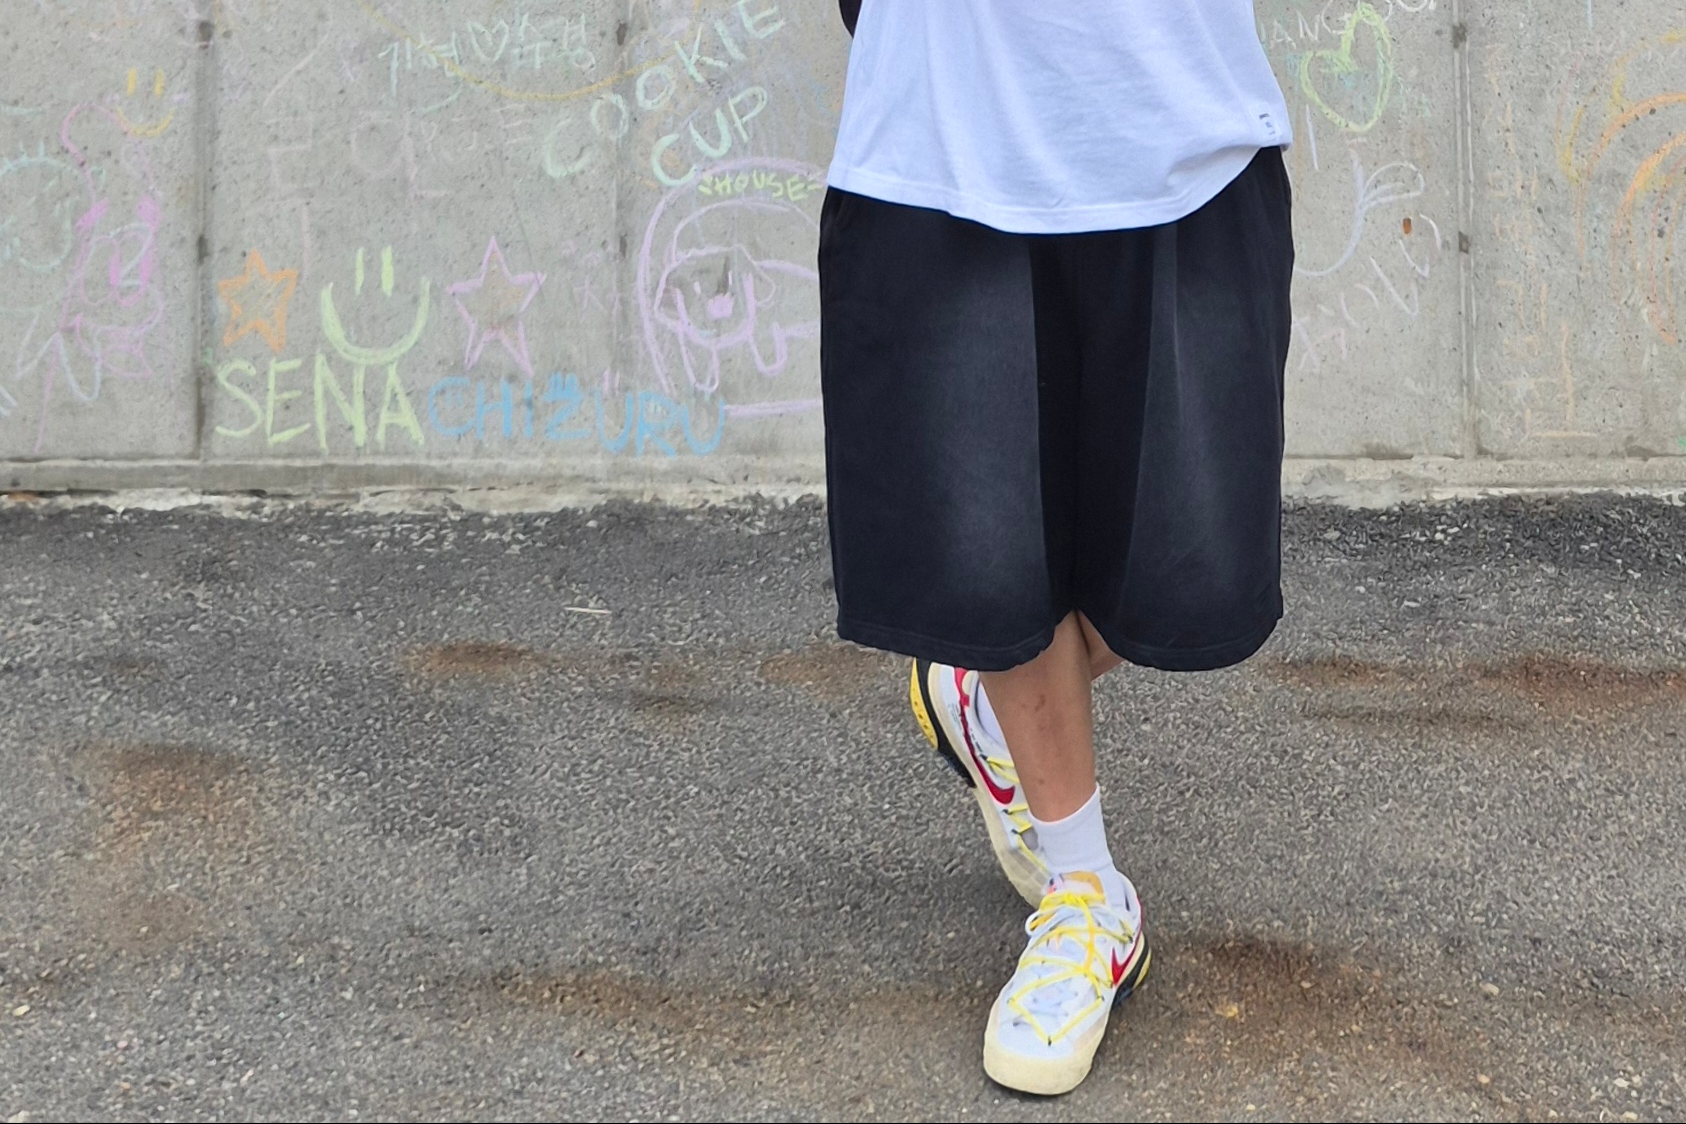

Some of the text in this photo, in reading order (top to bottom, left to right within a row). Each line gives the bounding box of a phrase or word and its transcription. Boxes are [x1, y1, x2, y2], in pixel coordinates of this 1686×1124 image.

[650, 86, 769, 188] CUP
[714, 169, 806, 202] HOUSE
[215, 351, 425, 456] SENA
[428, 373, 725, 457] CHIZURU
